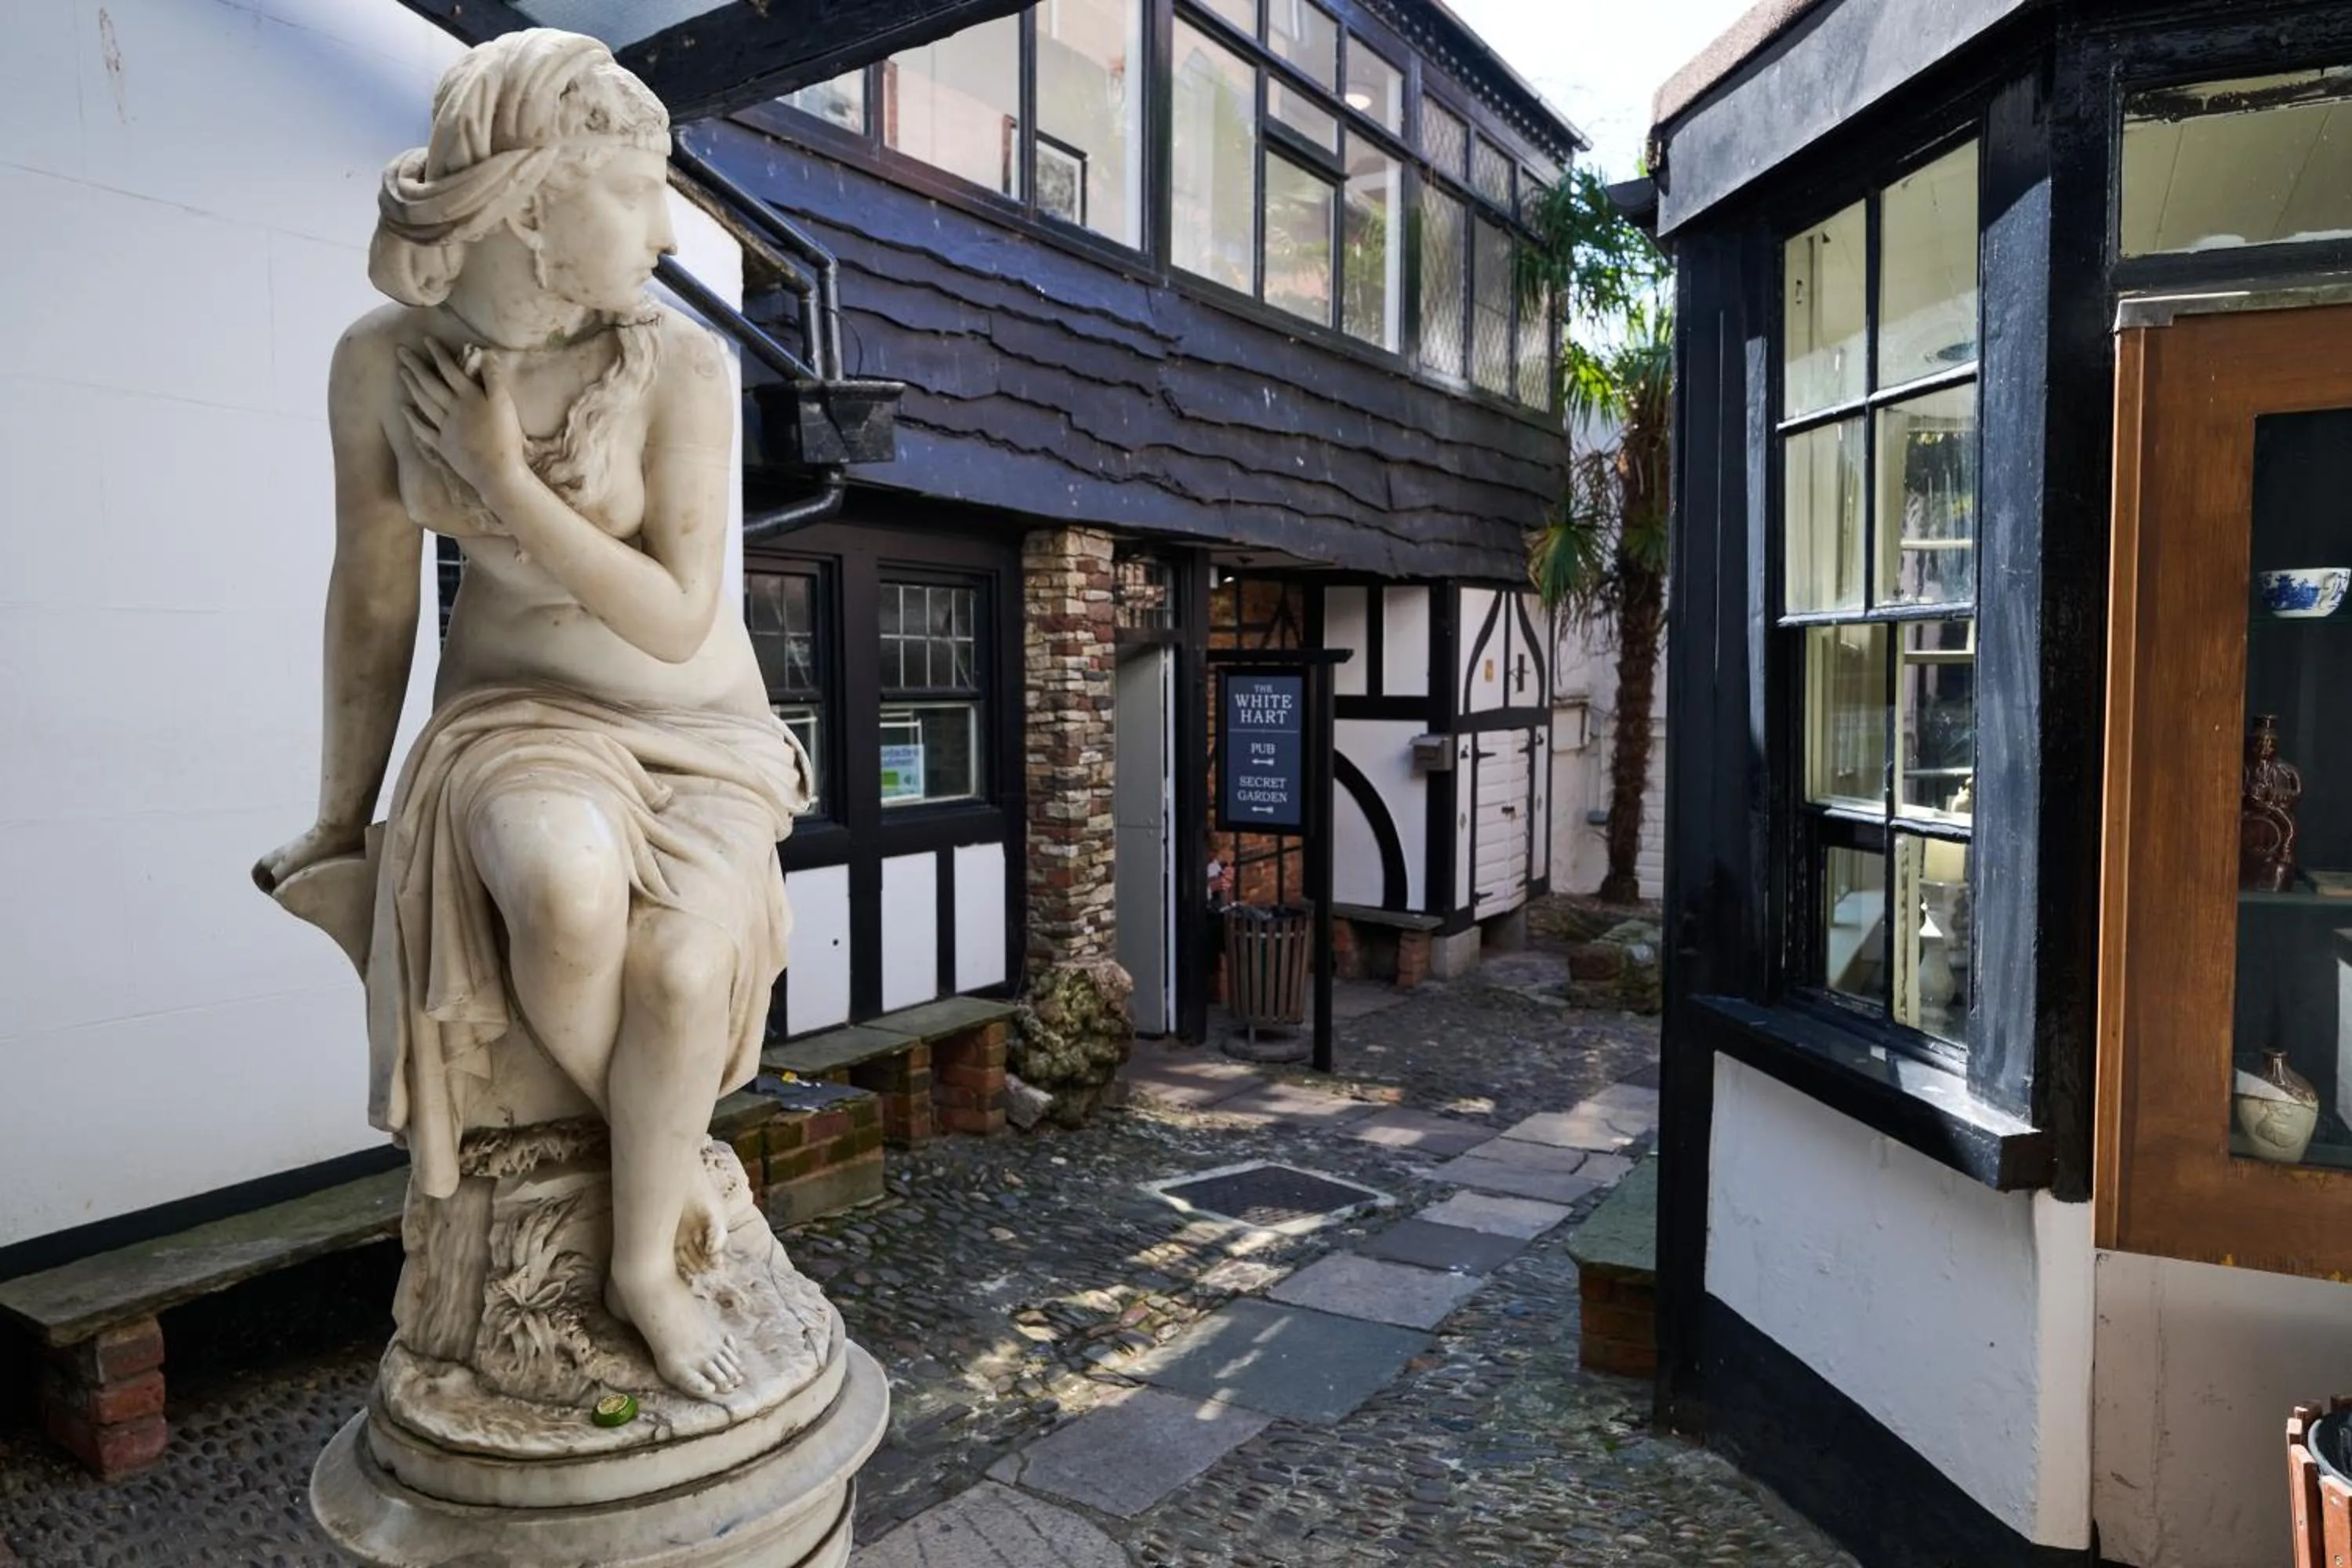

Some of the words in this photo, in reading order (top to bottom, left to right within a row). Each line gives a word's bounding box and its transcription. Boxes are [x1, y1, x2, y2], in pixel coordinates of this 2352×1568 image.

[1254, 684, 1273, 694] THE
[1235, 693, 1292, 709] WHITE
[1241, 709, 1287, 724] HART
[1251, 742, 1276, 755] PUB
[1239, 775, 1287, 789] SECRET
[1237, 789, 1287, 803] GARDEN
